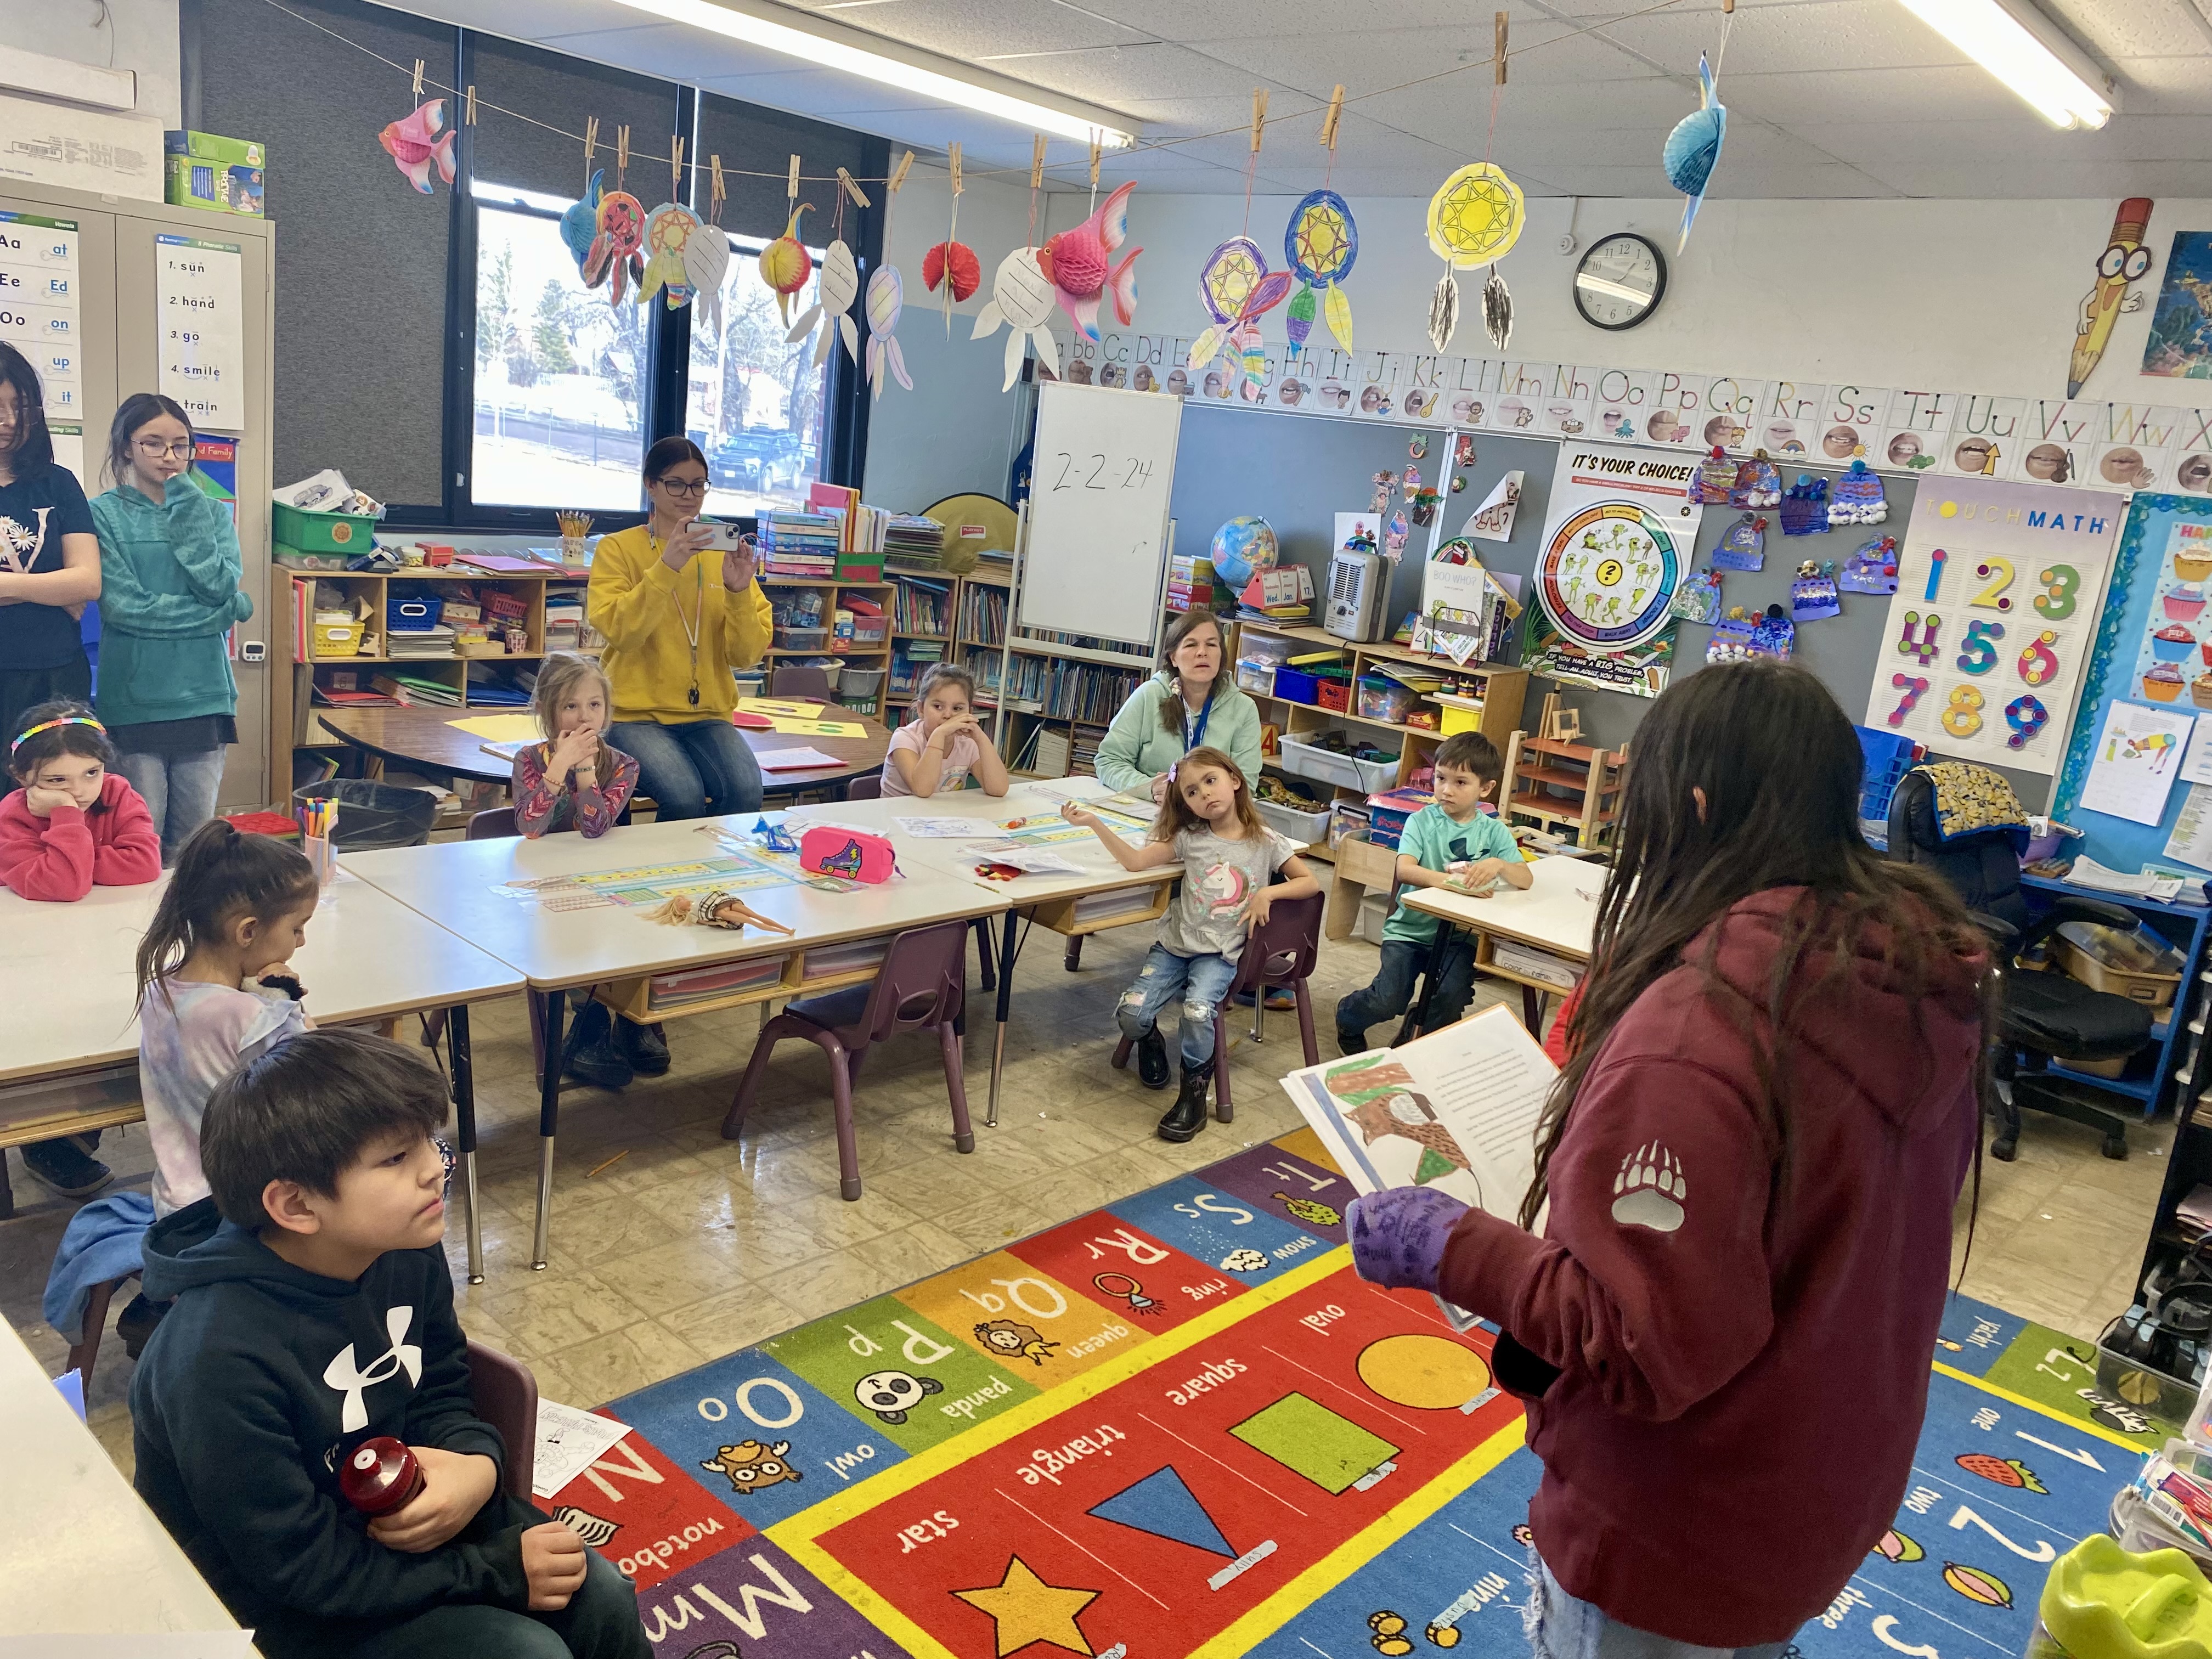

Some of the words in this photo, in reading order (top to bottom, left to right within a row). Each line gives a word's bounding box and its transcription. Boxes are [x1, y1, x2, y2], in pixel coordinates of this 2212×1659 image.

[53, 244, 67, 255] at
[203, 241, 224, 250] Phonetic
[1605, 248, 1613, 258] 11
[1619, 244, 1630, 255] 12
[1637, 249, 1640, 259] 1
[169, 261, 176, 269] 1.
[1592, 261, 1601, 271] 10
[1644, 259, 1651, 270] 2
[0, 273, 20, 287] Ee
[50, 279, 67, 292] Ed
[1646, 276, 1652, 287] 3
[170, 297, 178, 305] 2.
[183, 296, 215, 309] hand
[1587, 292, 1593, 302] 8
[1596, 304, 1601, 315] 7
[1626, 305, 1632, 315] 5
[0, 311, 25, 325] Oo
[51, 320, 69, 329] on
[1610, 309, 1616, 319] 6
[170, 331, 178, 339] 3.
[1104, 334, 1128, 362] Cc
[53, 357, 70, 369] up
[1135, 336, 1164, 365] Dd
[1283, 346, 1314, 377] Hh
[171, 365, 179, 373] 4.
[184, 365, 221, 376] smile
[1412, 355, 1442, 388] Kk
[1497, 361, 1542, 397] Mm
[1553, 364, 1589, 400] Nn
[61, 391, 71, 402] it
[1600, 370, 1644, 405] Oo
[1658, 373, 1698, 423] Pp
[1772, 381, 1814, 419] Rr
[184, 399, 217, 411] train
[1708, 377, 1753, 429] Qq
[1833, 386, 1875, 424] Ss
[1904, 391, 1943, 431] Tt
[1966, 395, 2016, 438] Uu
[2040, 400, 2086, 442] Vv
[2108, 402, 2174, 447] Ww
[208, 445, 233, 459] Family
[1572, 454, 1599, 470] IT'S
[1600, 457, 1635, 474] YOUR
[1638, 461, 1694, 482] CHOICE!
[2028, 510, 2105, 534] MATH
[1658, 536, 1666, 545] OUT
[1434, 570, 1451, 582] BOO
[1453, 574, 1477, 586] WHO?
[1924, 549, 1948, 602] 1
[1970, 556, 2015, 612] 2
[1266, 594, 1279, 603] Wed.
[1283, 592, 1293, 601] Jan.
[2033, 564, 2081, 620] 3
[1642, 604, 1658, 624] IGNORE
[1898, 611, 1940, 664] 4
[1956, 620, 2006, 674] 5
[1595, 660, 1613, 670] BIG
[1615, 665, 1644, 678] PROBLEM,
[2018, 630, 2059, 685] 6
[1581, 669, 1599, 677] ADULT
[1614, 675, 1633, 684] TRUST.
[1887, 673, 1929, 725] 7
[1941, 684, 1985, 737] 8
[2005, 695, 2049, 751] 9
[1272, 1235, 1318, 1261] snow
[1181, 1278, 1229, 1302] ring
[1299, 1304, 1346, 1337] oval
[1066, 1323, 1130, 1361] queen
[1165, 1358, 1248, 1406] square
[940, 1375, 1013, 1421] panda
[1971, 1407, 2001, 1431] one
[825, 1443, 876, 1481] owl
[1015, 1423, 1127, 1486] triangle
[2015, 1430, 2107, 1474] 1
[1904, 1486, 1943, 1515] two
[618, 1516, 725, 1575] notebo
[896, 1510, 960, 1554] star
[1948, 1505, 2057, 1563] 2
[1468, 1571, 1510, 1612] nin
